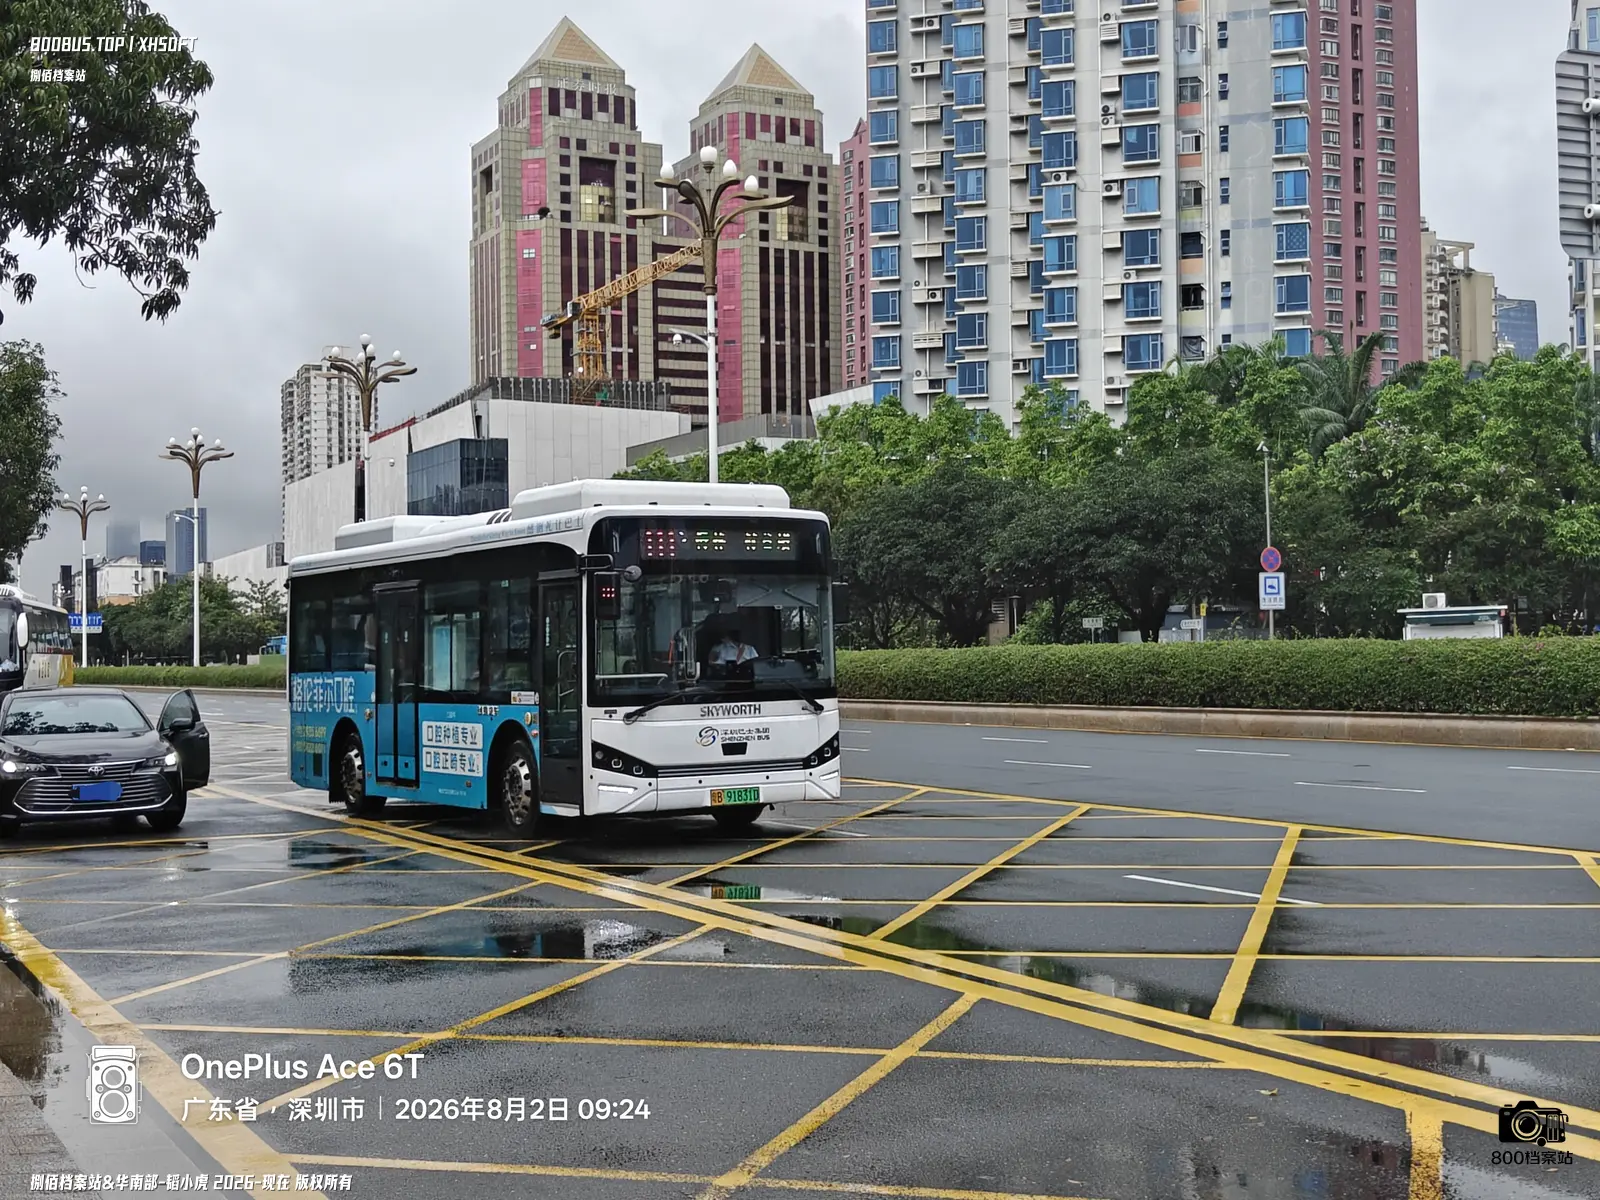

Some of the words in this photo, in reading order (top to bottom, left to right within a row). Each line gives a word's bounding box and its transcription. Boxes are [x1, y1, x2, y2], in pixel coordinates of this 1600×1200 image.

[700, 704, 761, 717] SKYWORTH
[426, 724, 478, 745] 口腔种植专业
[425, 751, 476, 773] 口腔正畸专业
